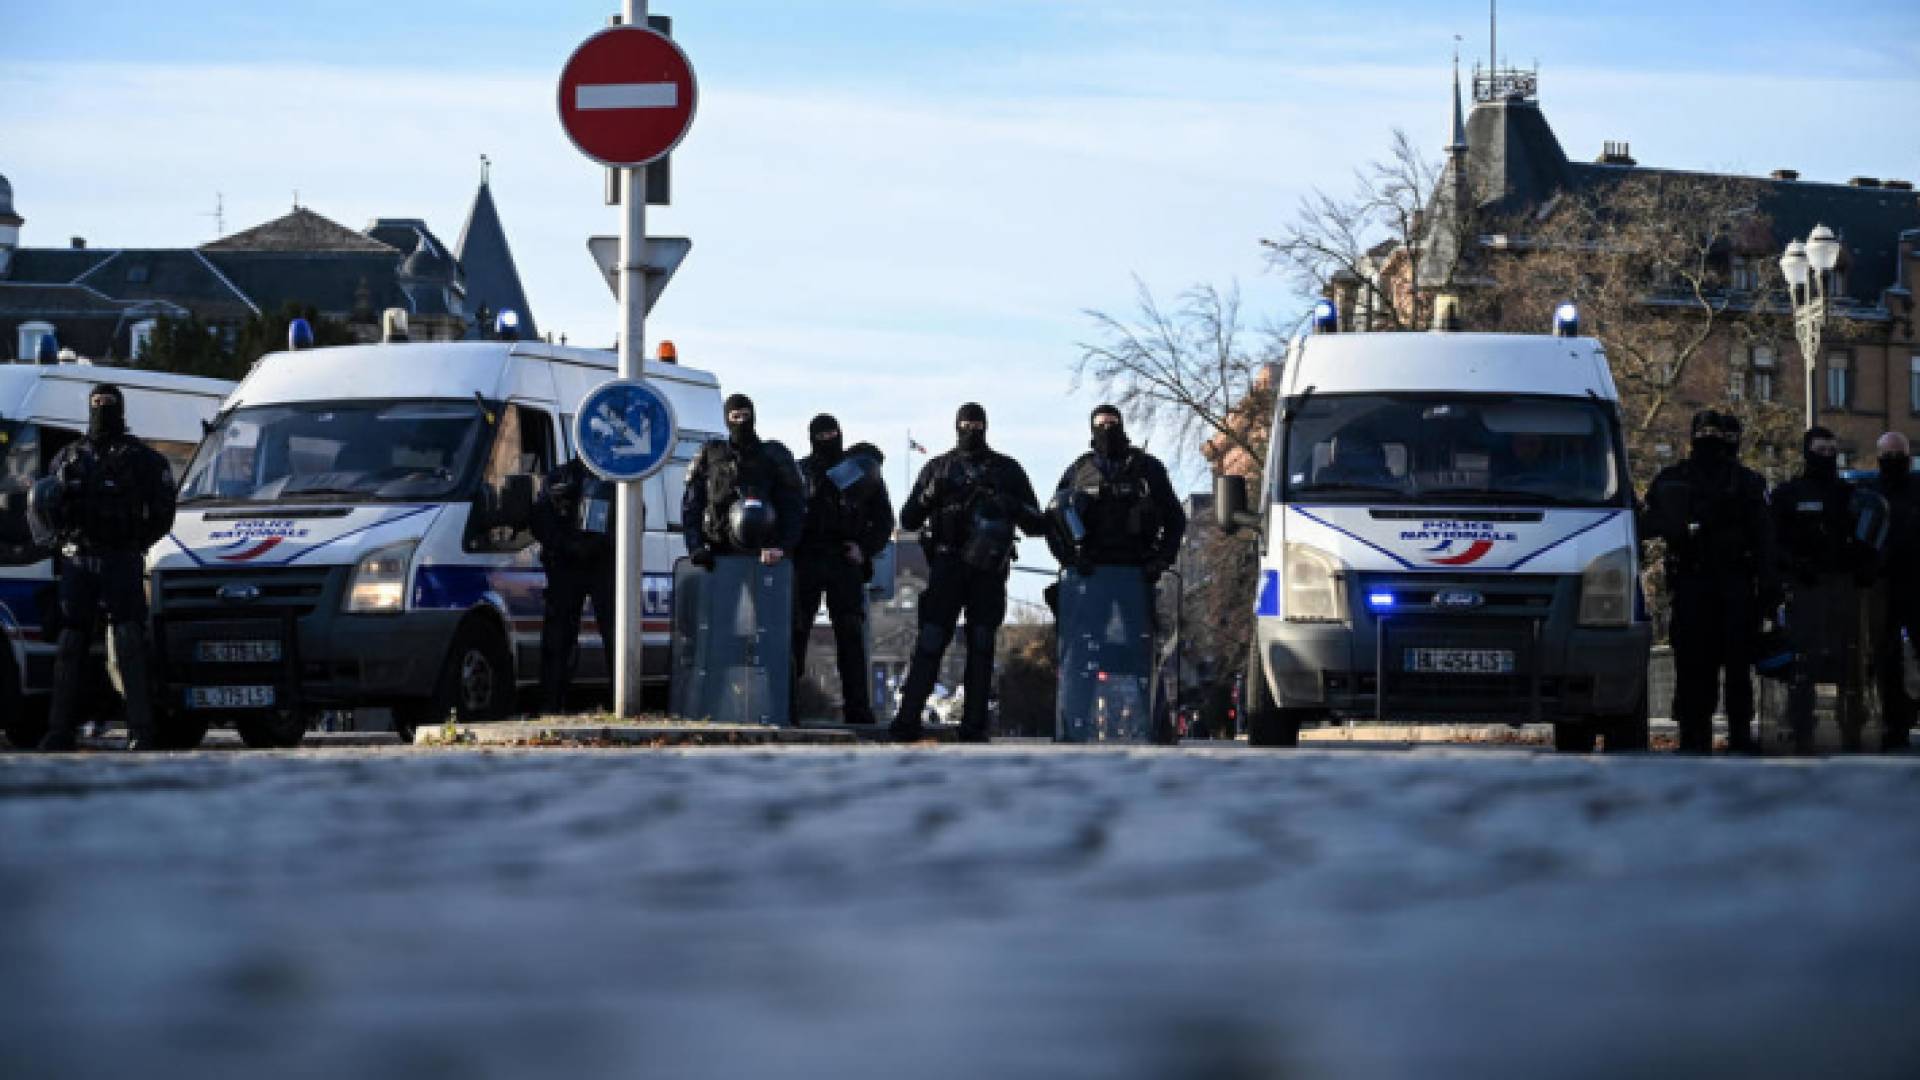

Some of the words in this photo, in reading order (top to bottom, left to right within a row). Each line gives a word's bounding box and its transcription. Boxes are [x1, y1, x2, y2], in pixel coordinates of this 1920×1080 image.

[234, 520, 294, 530] POLICE
[1422, 520, 1494, 529] POLICE
[1400, 532, 1518, 541] NATIONALE
